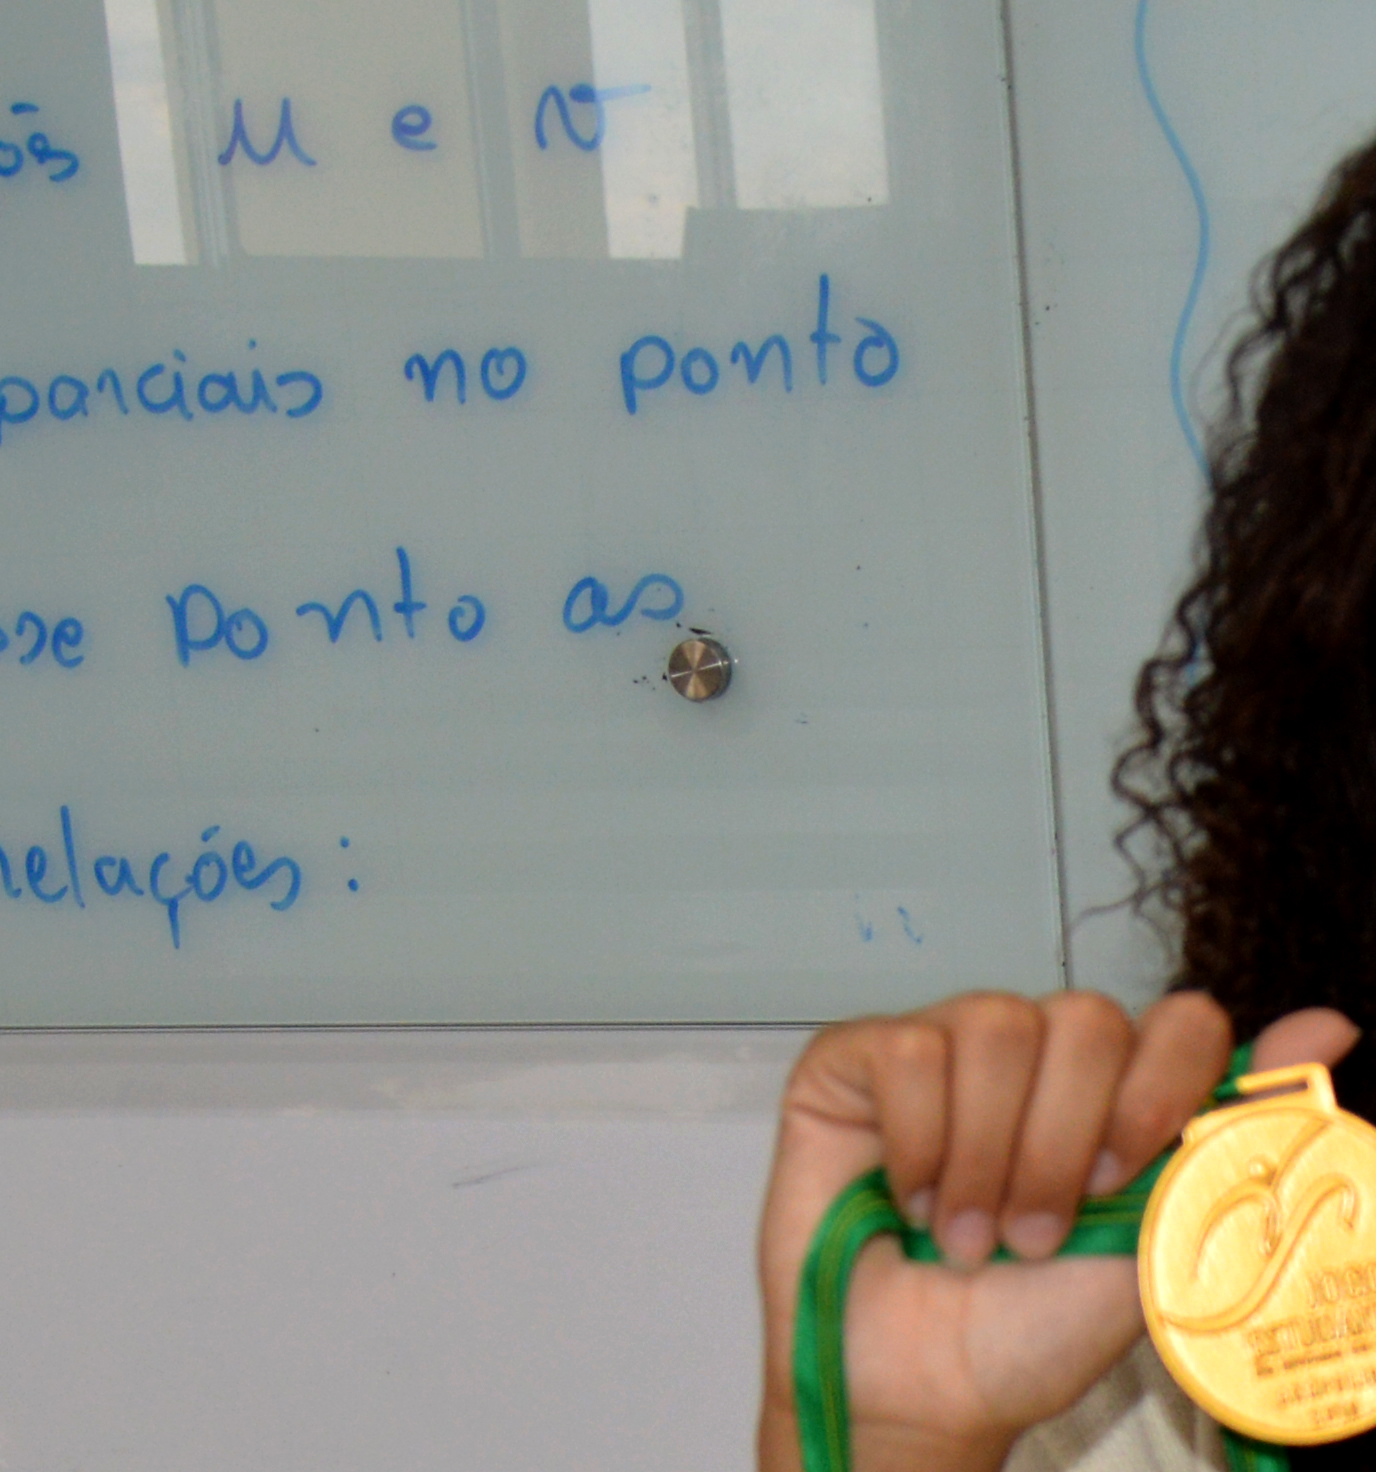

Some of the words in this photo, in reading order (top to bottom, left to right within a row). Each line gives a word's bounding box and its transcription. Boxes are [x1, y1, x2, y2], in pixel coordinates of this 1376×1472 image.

[391, 104, 437, 151] e
[402, 343, 533, 405] no
[618, 272, 904, 416] ponto
[561, 571, 688, 636] as
